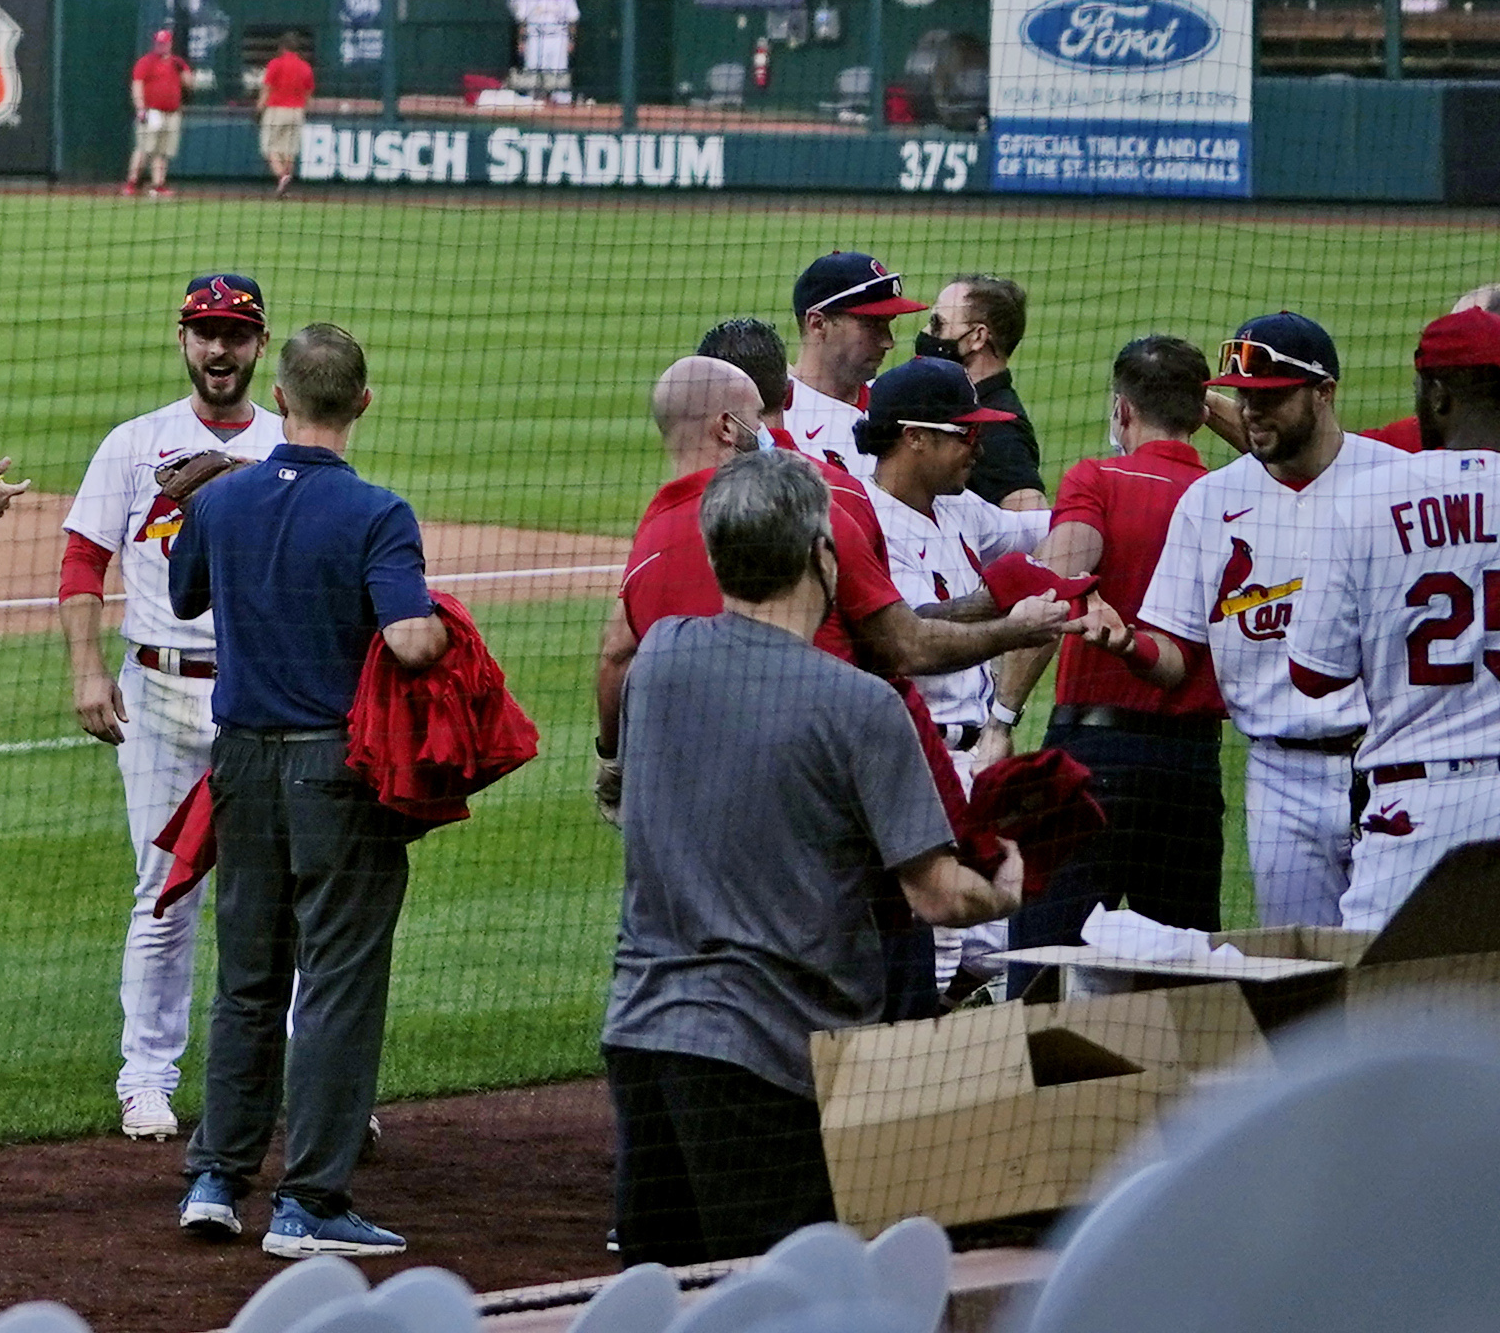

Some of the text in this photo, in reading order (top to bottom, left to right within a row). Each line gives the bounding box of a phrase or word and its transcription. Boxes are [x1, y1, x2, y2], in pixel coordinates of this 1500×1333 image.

[1058, 1, 1180, 59] Ford
[300, 124, 724, 188] BUSCH STADIUM
[997, 134, 1240, 158] OFFICIAL TRUCK AND CAR
[997, 158, 1022, 176] OF
[1026, 159, 1058, 176] THE
[1089, 160, 1139, 178] LOUIS
[1141, 161, 1240, 180] CARDINALS
[1405, 569, 1500, 687] 2
